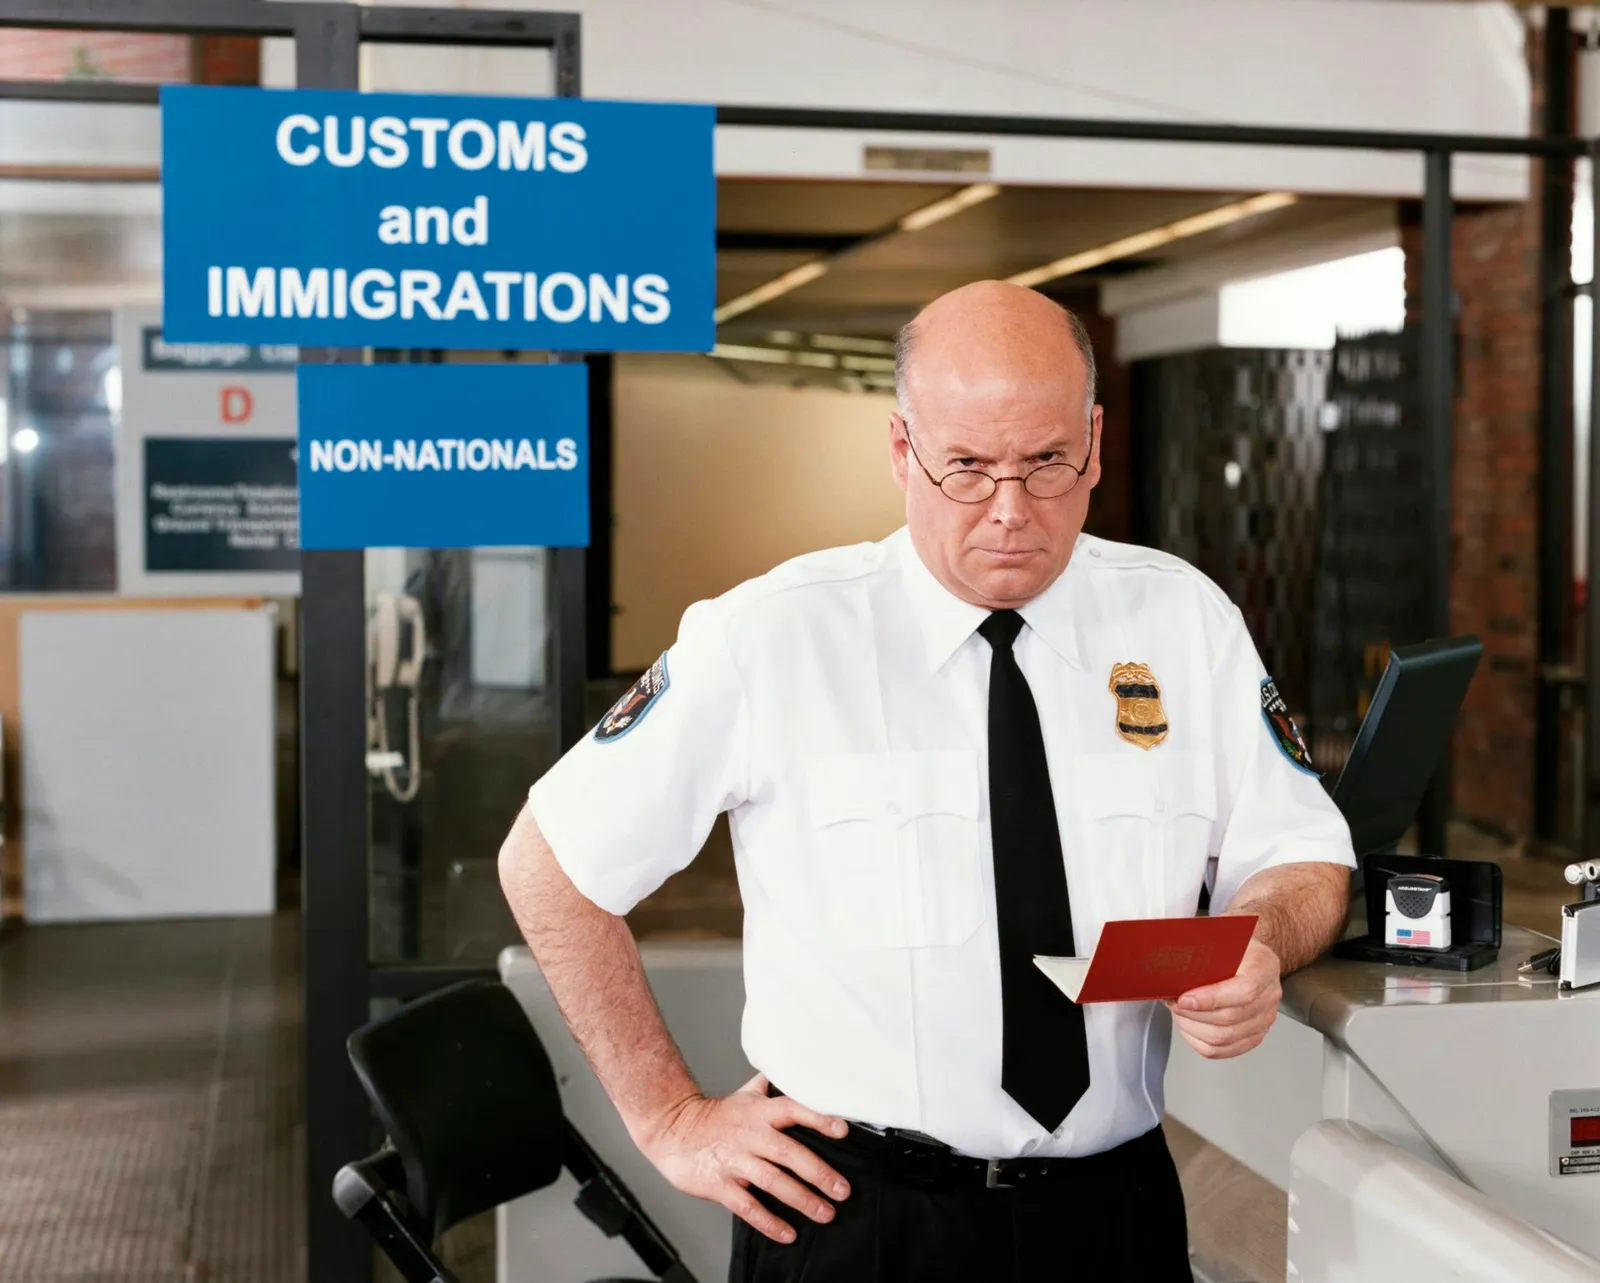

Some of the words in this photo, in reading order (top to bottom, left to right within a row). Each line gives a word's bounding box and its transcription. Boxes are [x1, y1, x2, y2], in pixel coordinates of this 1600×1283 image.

[276, 114, 588, 173] CUSTOMS
[378, 195, 488, 246] and
[207, 266, 671, 325] IMMIGRATIONS
[219, 385, 254, 424] D
[309, 437, 578, 473] NON-NATIONALS
